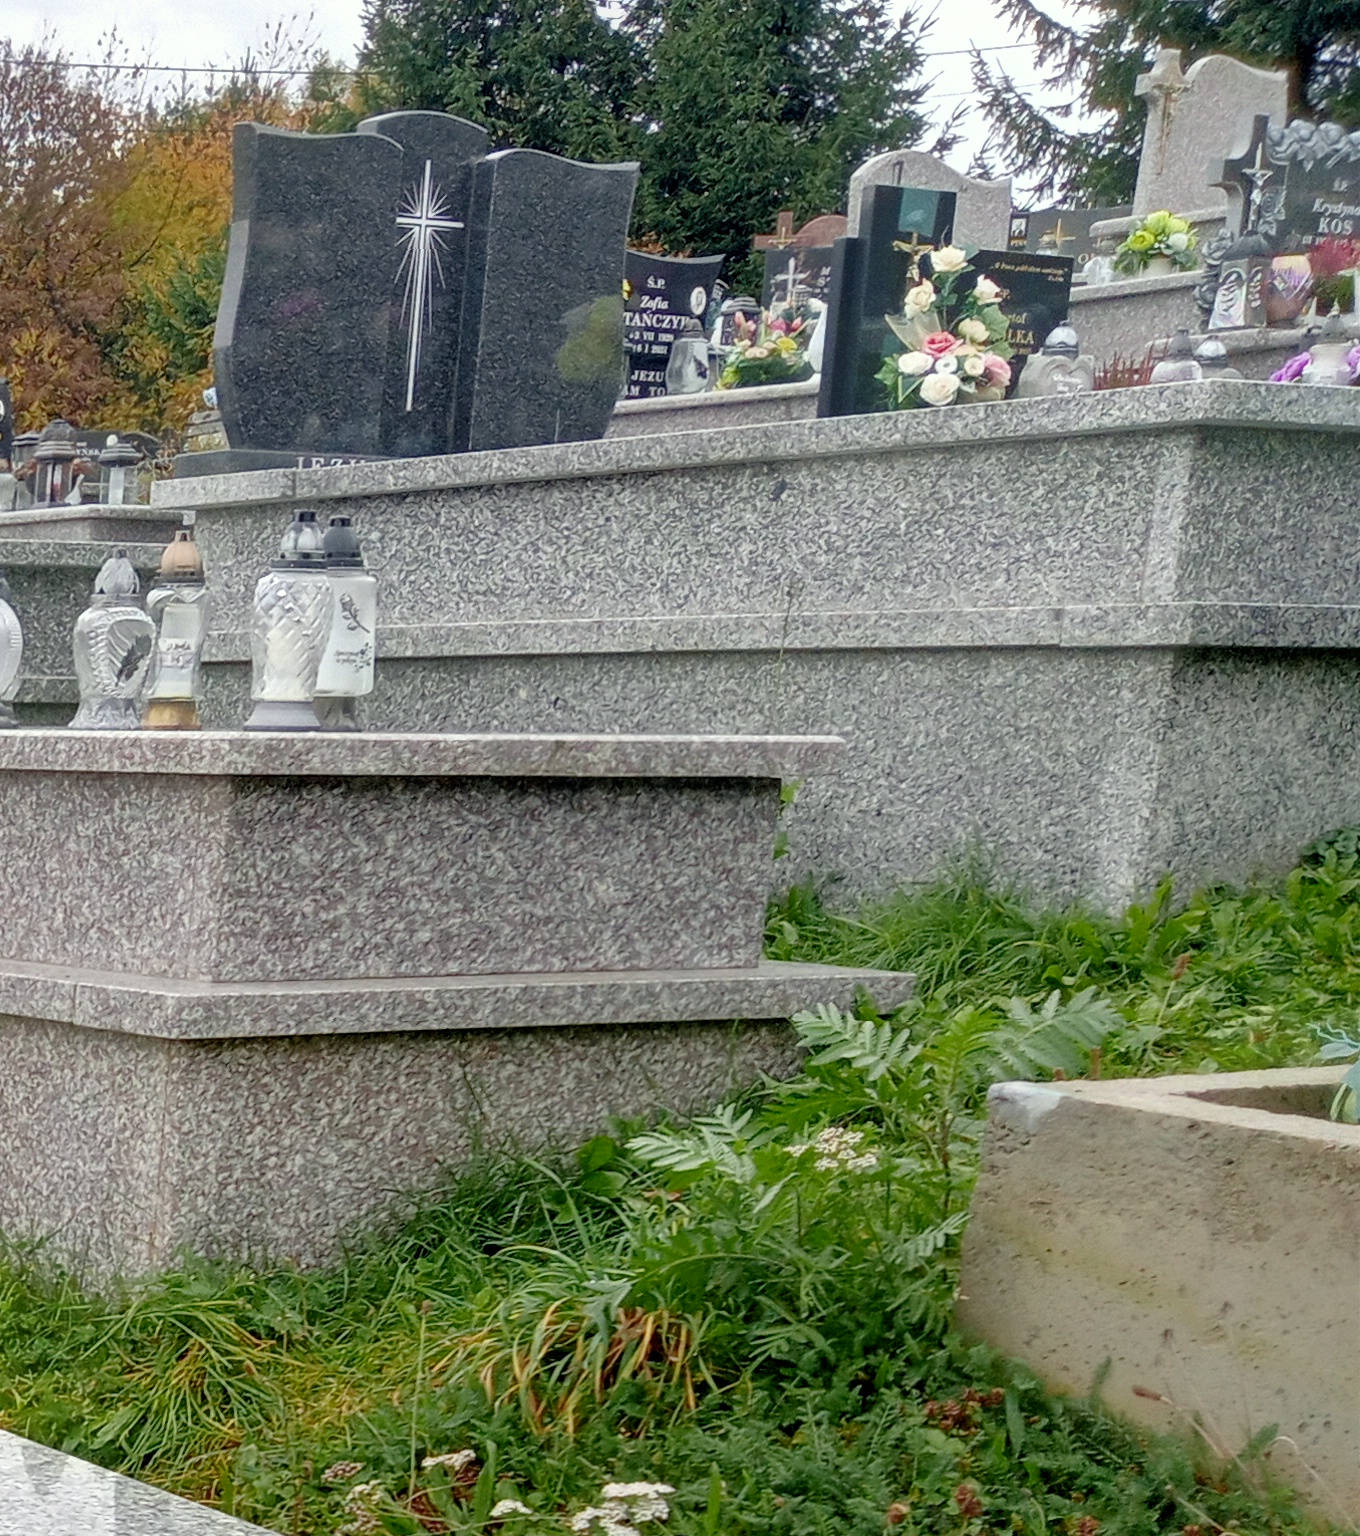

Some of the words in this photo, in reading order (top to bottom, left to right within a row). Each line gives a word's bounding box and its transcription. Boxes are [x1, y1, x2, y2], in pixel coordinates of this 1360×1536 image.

[1318, 217, 1354, 235] KOS
[640, 295, 669, 311] Zofia
[623, 310, 690, 329] TAŃCZY
[1008, 330, 1035, 345] LKA
[631, 369, 665, 382] JEZU
